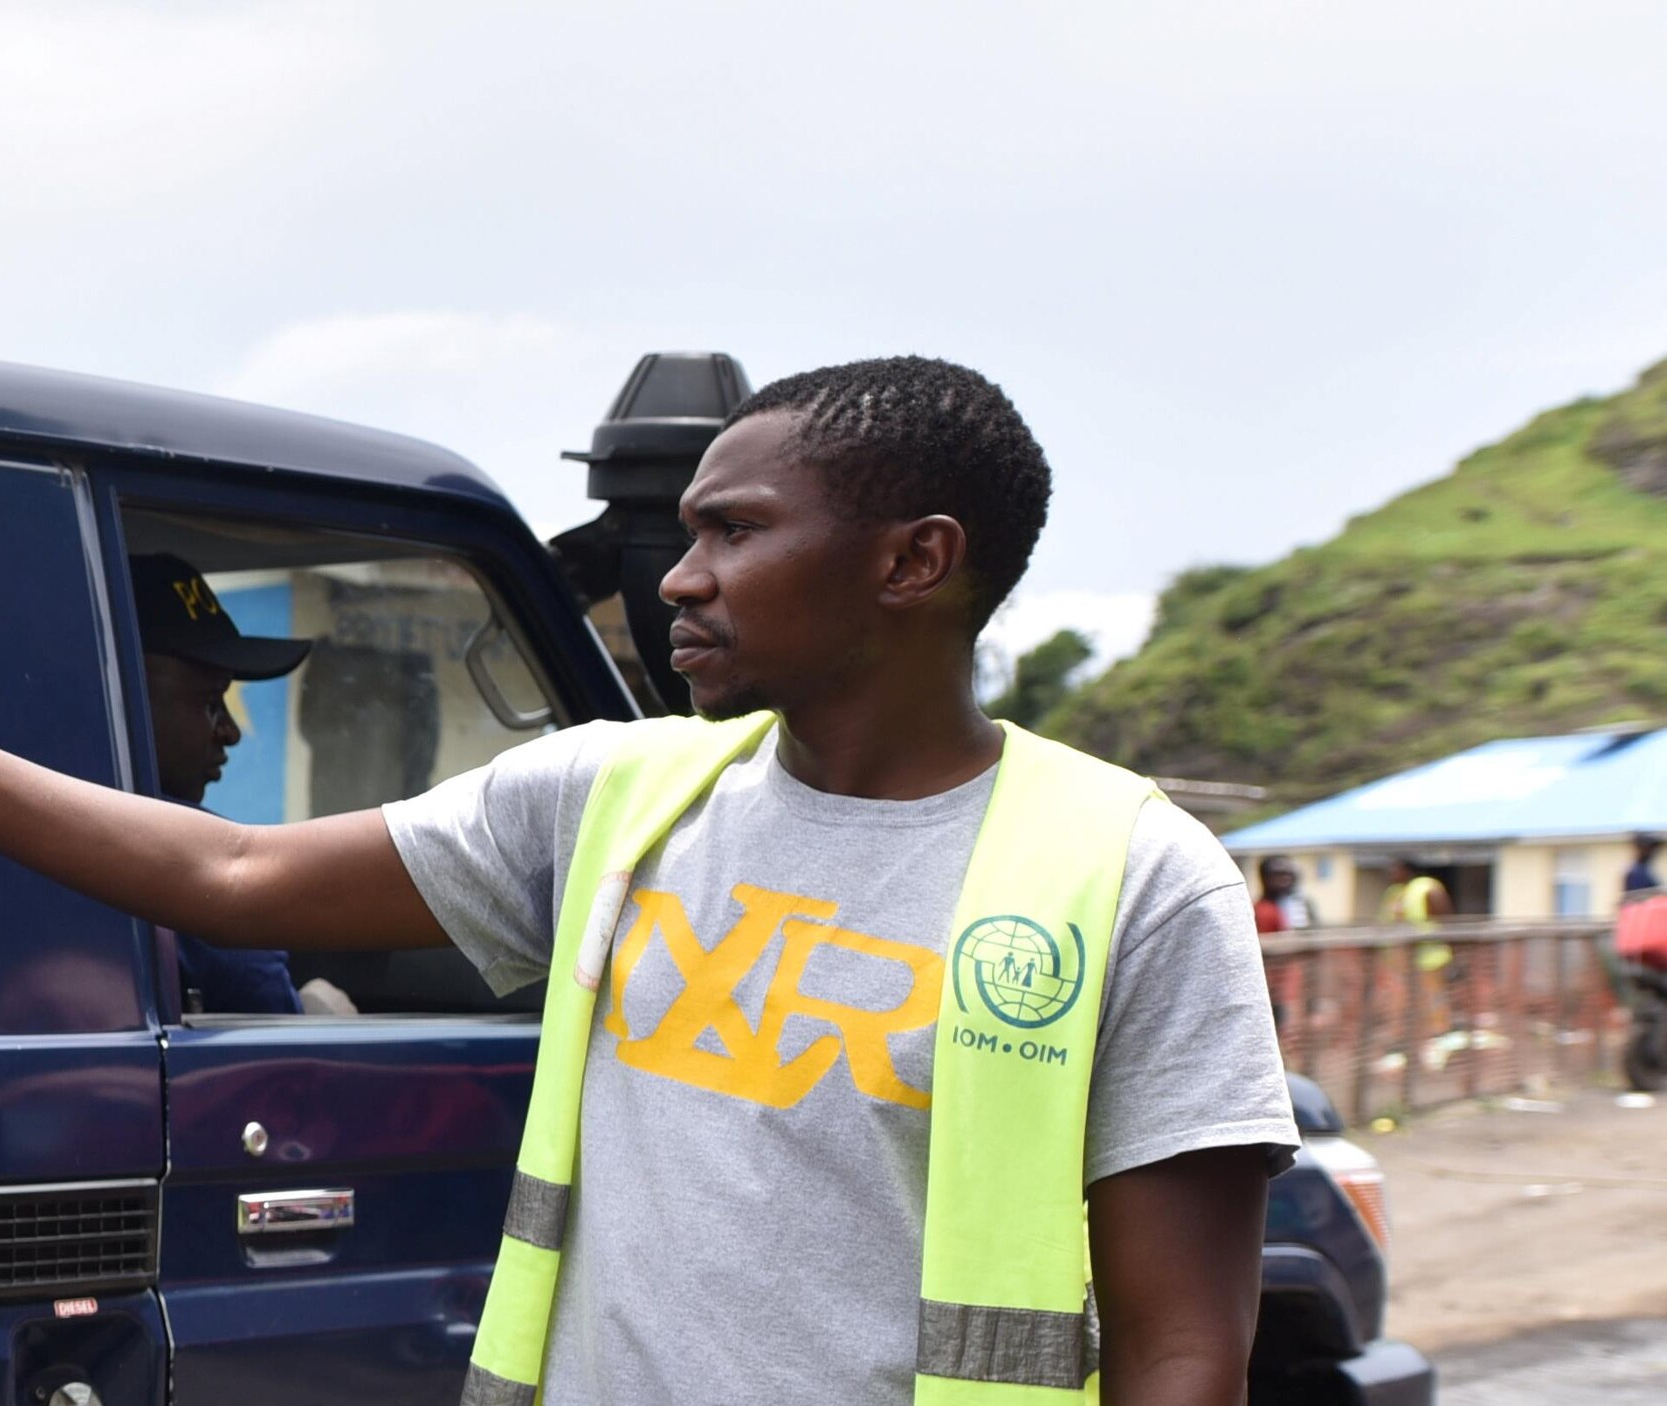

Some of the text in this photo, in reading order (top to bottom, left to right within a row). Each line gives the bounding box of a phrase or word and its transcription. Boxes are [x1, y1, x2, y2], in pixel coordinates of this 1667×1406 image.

[952, 1026, 1068, 1066] IOM OIM
[58, 1299, 94, 1317] DIESEL
